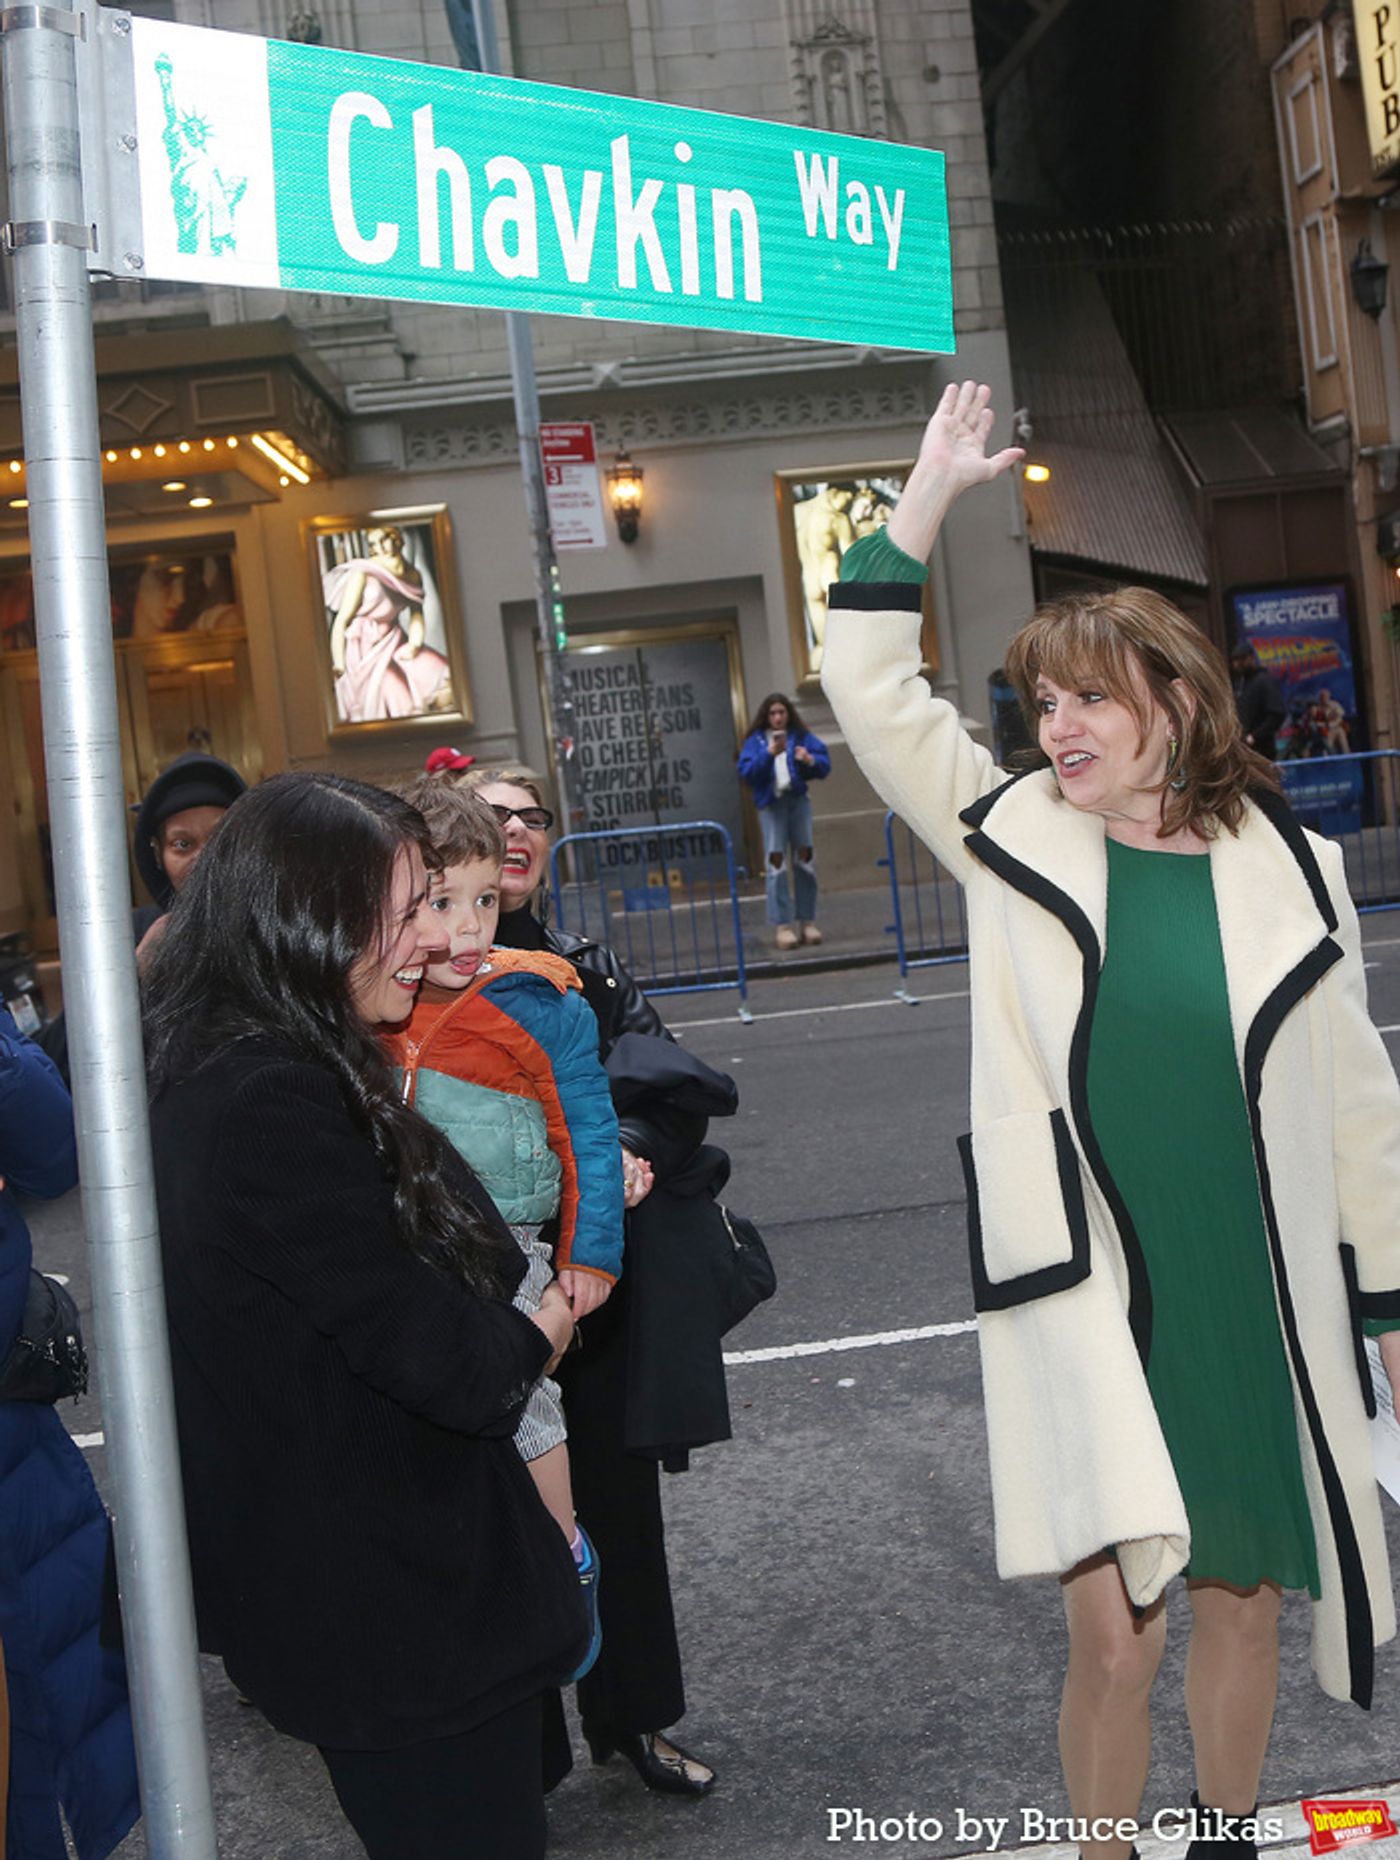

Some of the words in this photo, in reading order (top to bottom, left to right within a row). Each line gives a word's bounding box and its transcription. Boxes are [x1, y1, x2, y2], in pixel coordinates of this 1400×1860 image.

[1371, 5, 1400, 140] PUB
[328, 91, 763, 302] Chavkin
[793, 150, 906, 271] Way
[549, 466, 560, 484] 3
[1243, 603, 1340, 628] SPECTACLE
[575, 688, 645, 718] HEATER
[646, 682, 694, 710] FANS
[581, 716, 616, 742] AVE
[581, 744, 594, 768] O
[582, 761, 669, 794] EMPICKA
[672, 758, 692, 783] IS
[598, 832, 723, 868] LOCKBUSTER
